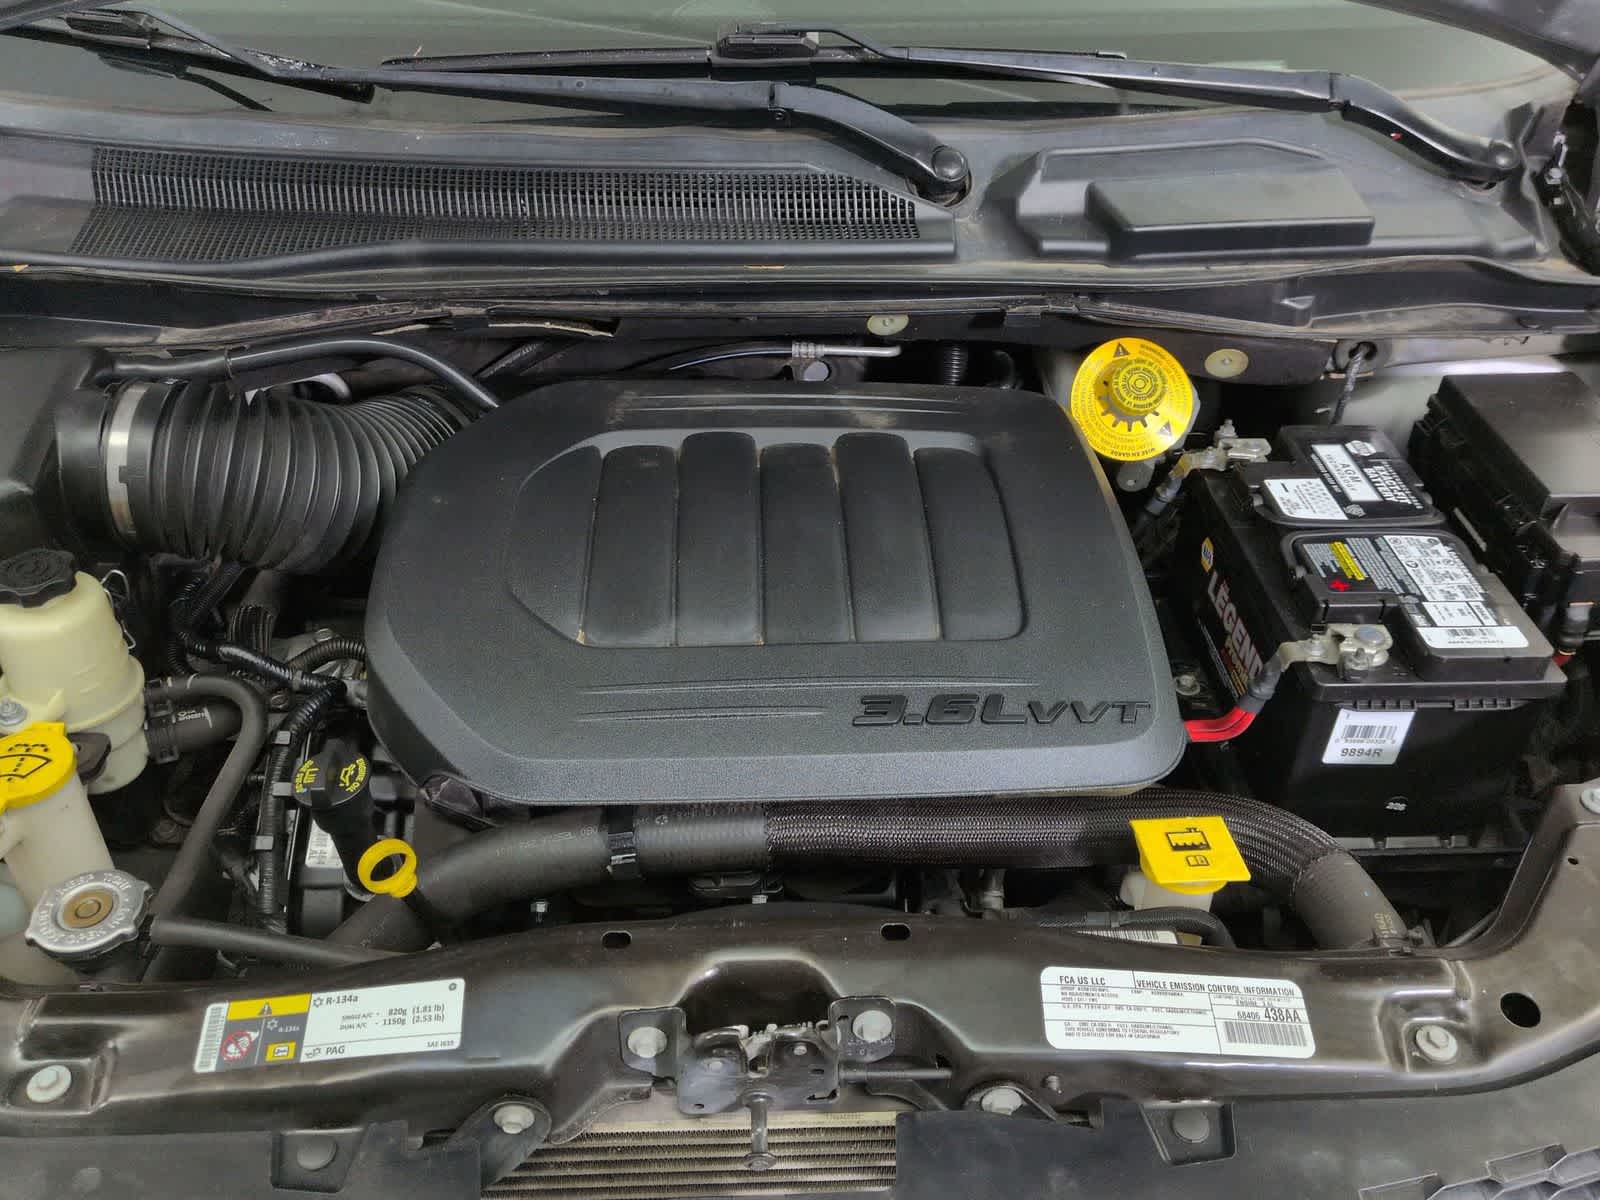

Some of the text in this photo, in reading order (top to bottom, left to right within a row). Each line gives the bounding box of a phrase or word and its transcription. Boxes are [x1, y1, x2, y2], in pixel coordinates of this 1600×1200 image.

[1340, 462, 1361, 483] AGM
[1363, 467, 1398, 502] BATTERY
[1340, 747, 1383, 757] 9894R
[1059, 975, 1106, 986] FCA US LLC
[1136, 979, 1294, 996] VEHICLE EMISSION CONTROL INFORMATION
[325, 994, 359, 1005] R-134a
[388, 1007, 407, 1016] 820g
[412, 1005, 432, 1014] (1.81
[433, 1003, 445, 1013] lb)
[1264, 1007, 1302, 1022] 438AA
[383, 1017, 406, 1026] 1150g
[412, 1015, 432, 1024] (2.53
[433, 1013, 445, 1022] lb)
[325, 1045, 345, 1055] PAG
